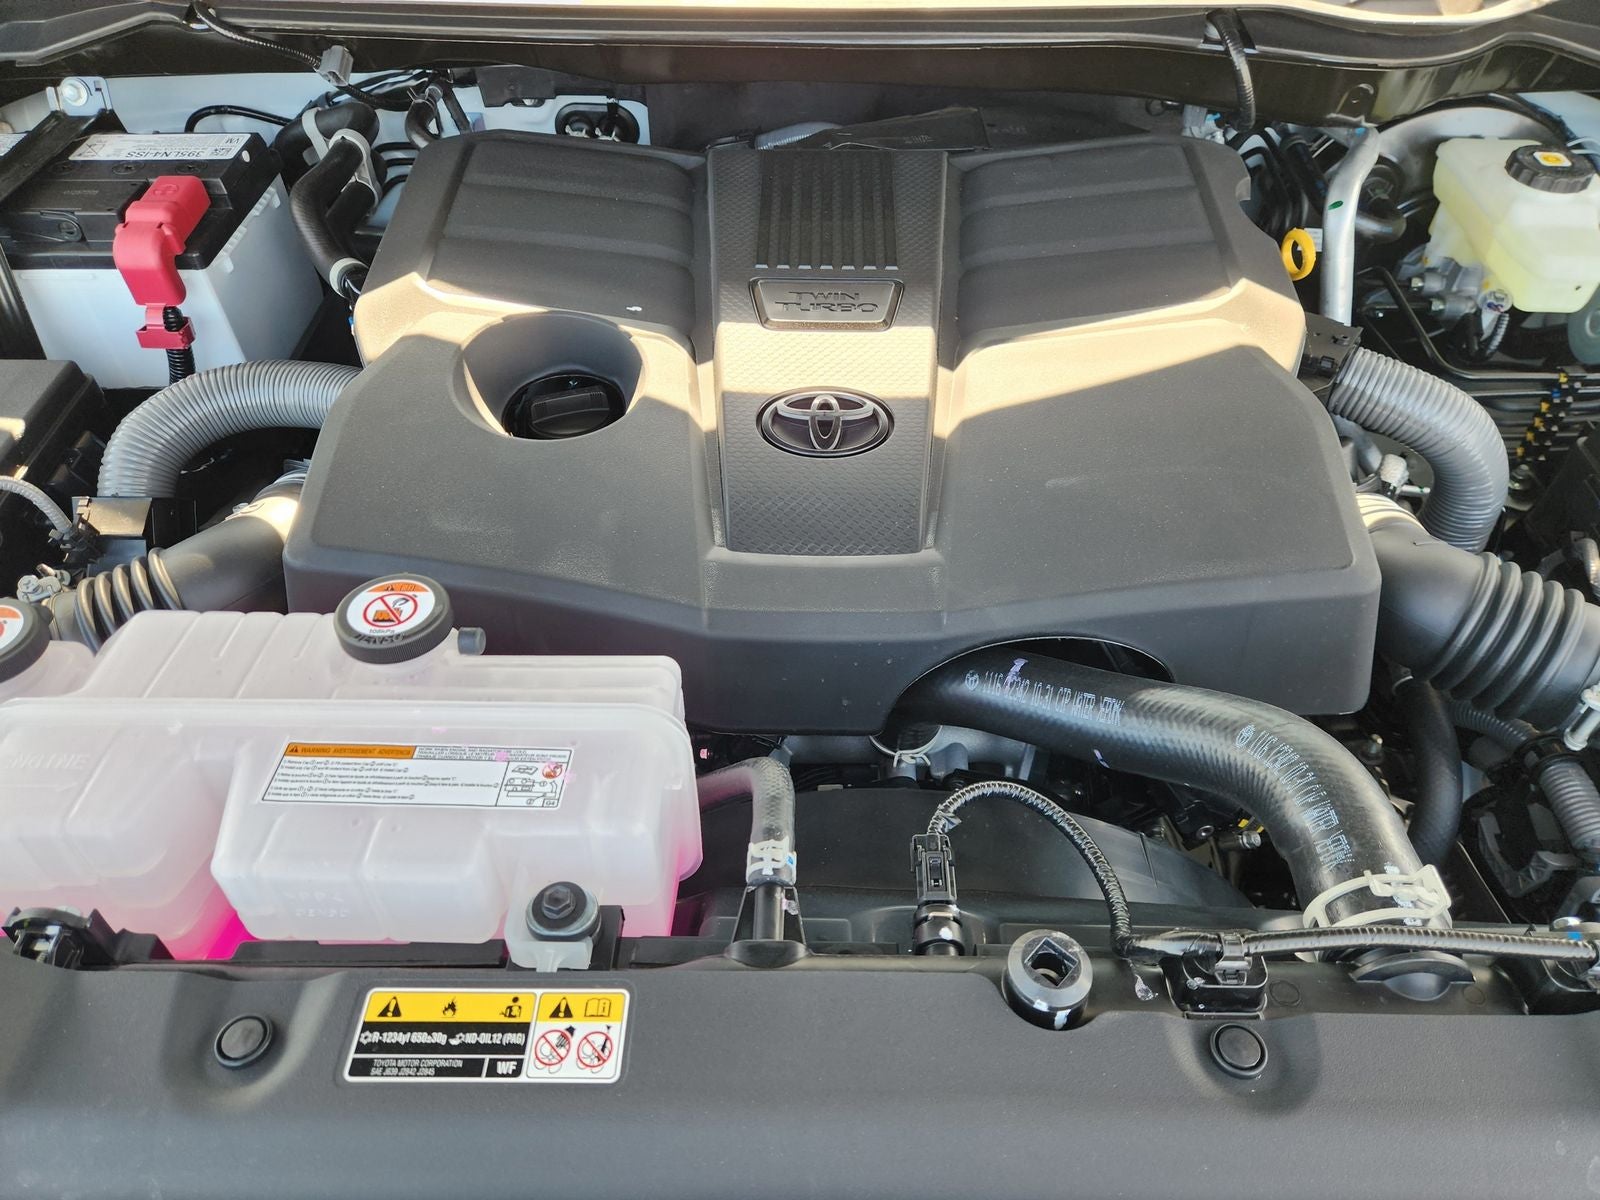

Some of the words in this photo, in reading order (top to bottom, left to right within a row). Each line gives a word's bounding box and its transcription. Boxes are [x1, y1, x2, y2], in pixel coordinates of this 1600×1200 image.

[788, 291, 860, 301] TWIN
[775, 301, 879, 313] TURBO
[1072, 691, 1096, 721] WATER
[502, 1032, 526, 1046] (PAG)
[373, 1058, 396, 1068] TOYOTA
[397, 1058, 420, 1068] MOTOR
[420, 1059, 464, 1068] CORPORATION
[496, 1061, 518, 1075] WF
[370, 1068, 383, 1076] SAE
